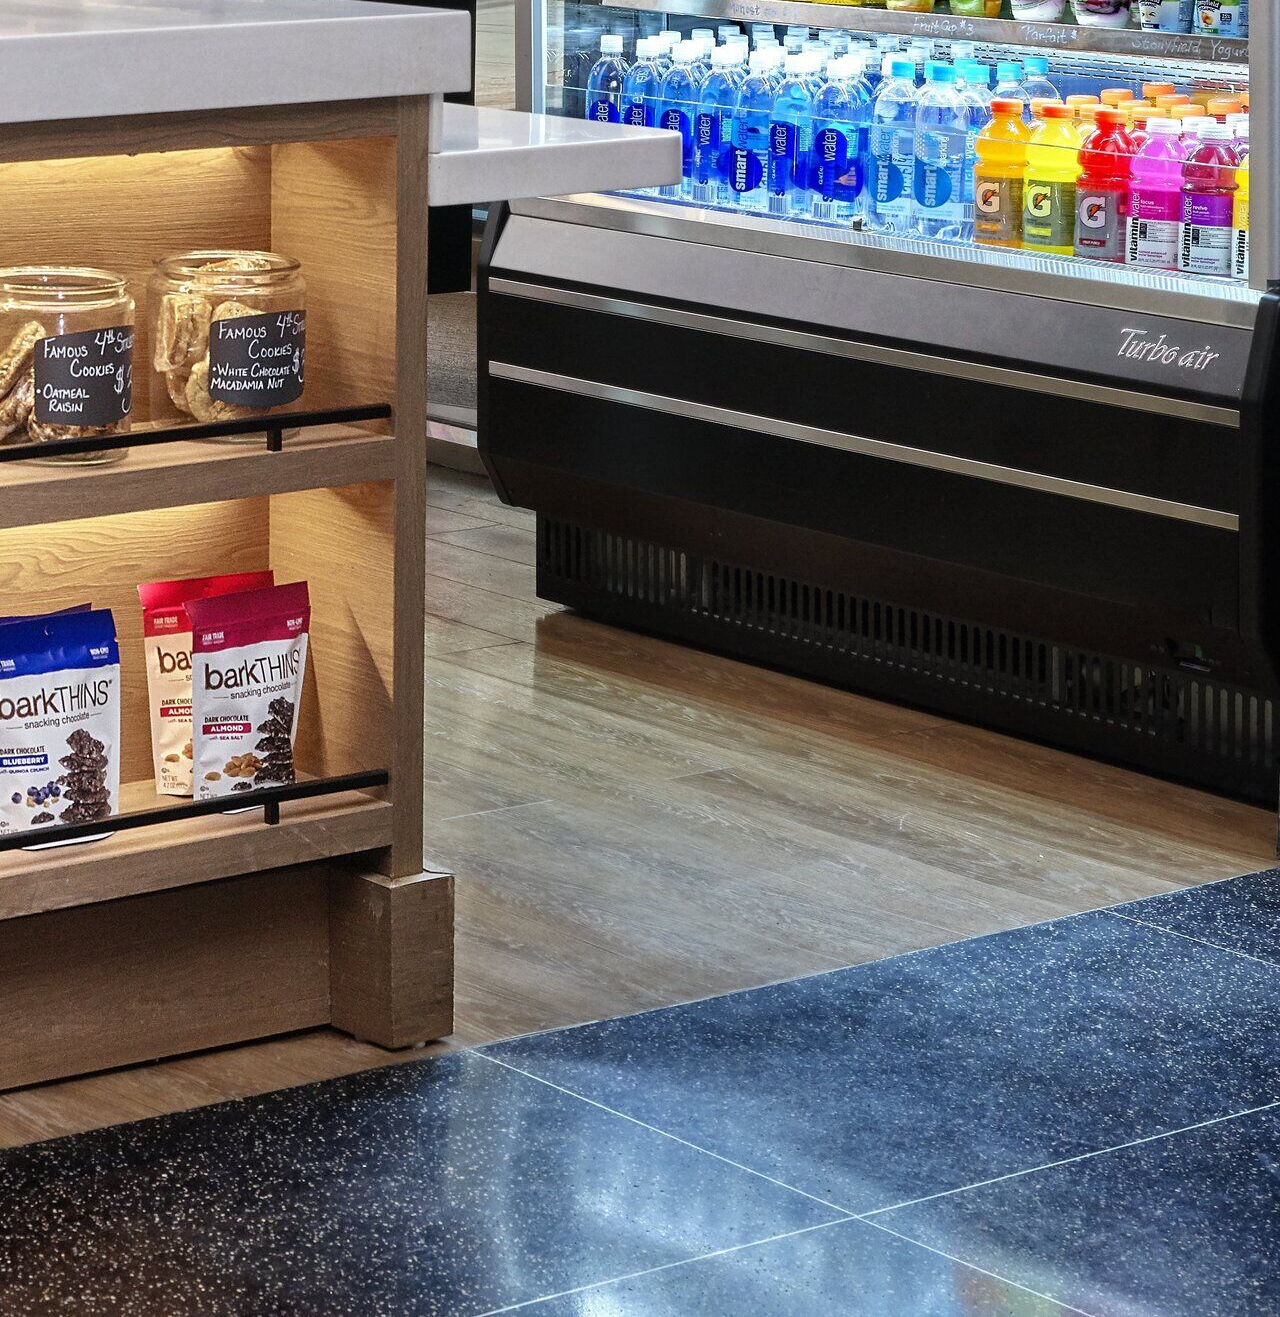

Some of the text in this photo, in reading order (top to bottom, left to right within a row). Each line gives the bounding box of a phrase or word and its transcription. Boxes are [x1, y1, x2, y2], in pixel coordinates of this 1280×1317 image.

[913, 17, 957, 34] Fruit Cup
[1022, 24, 1068, 44] Parfait
[1132, 36, 1202, 58] Stonyfield
[699, 116, 711, 146] water
[775, 124, 787, 157] water
[825, 129, 837, 162] water
[736, 149, 748, 192] smart
[877, 160, 889, 201] smart
[925, 162, 938, 207] smart
[976, 182, 1001, 214] G
[1027, 185, 1052, 218] G
[1079, 196, 1107, 229] G
[1129, 191, 1141, 262] vitaminwater
[1182, 195, 1194, 268] vitaminwater
[218, 321, 267, 340] FAMOUS
[44, 337, 89, 359] FAMOUS
[248, 338, 293, 360] COOKIES
[1117, 328, 1220, 371] Turbo air
[69, 358, 115, 378] COOKIES
[217, 362, 291, 378] WHITE CHOCOLATE
[43, 383, 90, 400] OATMEAL
[210, 377, 285, 391] MACADAMIA NUT
[48, 399, 83, 413] RAISIN
[204, 648, 300, 692] barkTHINS
[229, 681, 291, 701] snacking chocolate
[161, 698, 176, 707] DARK
[24, 711, 91, 730] snacking chocolate
[204, 714, 250, 724] DARK CHOCOLATE
[210, 724, 244, 733] ALMOND
[0, 745, 46, 755] DARK CHOCOLATE
[2, 756, 46, 767] BLUEBERRY
